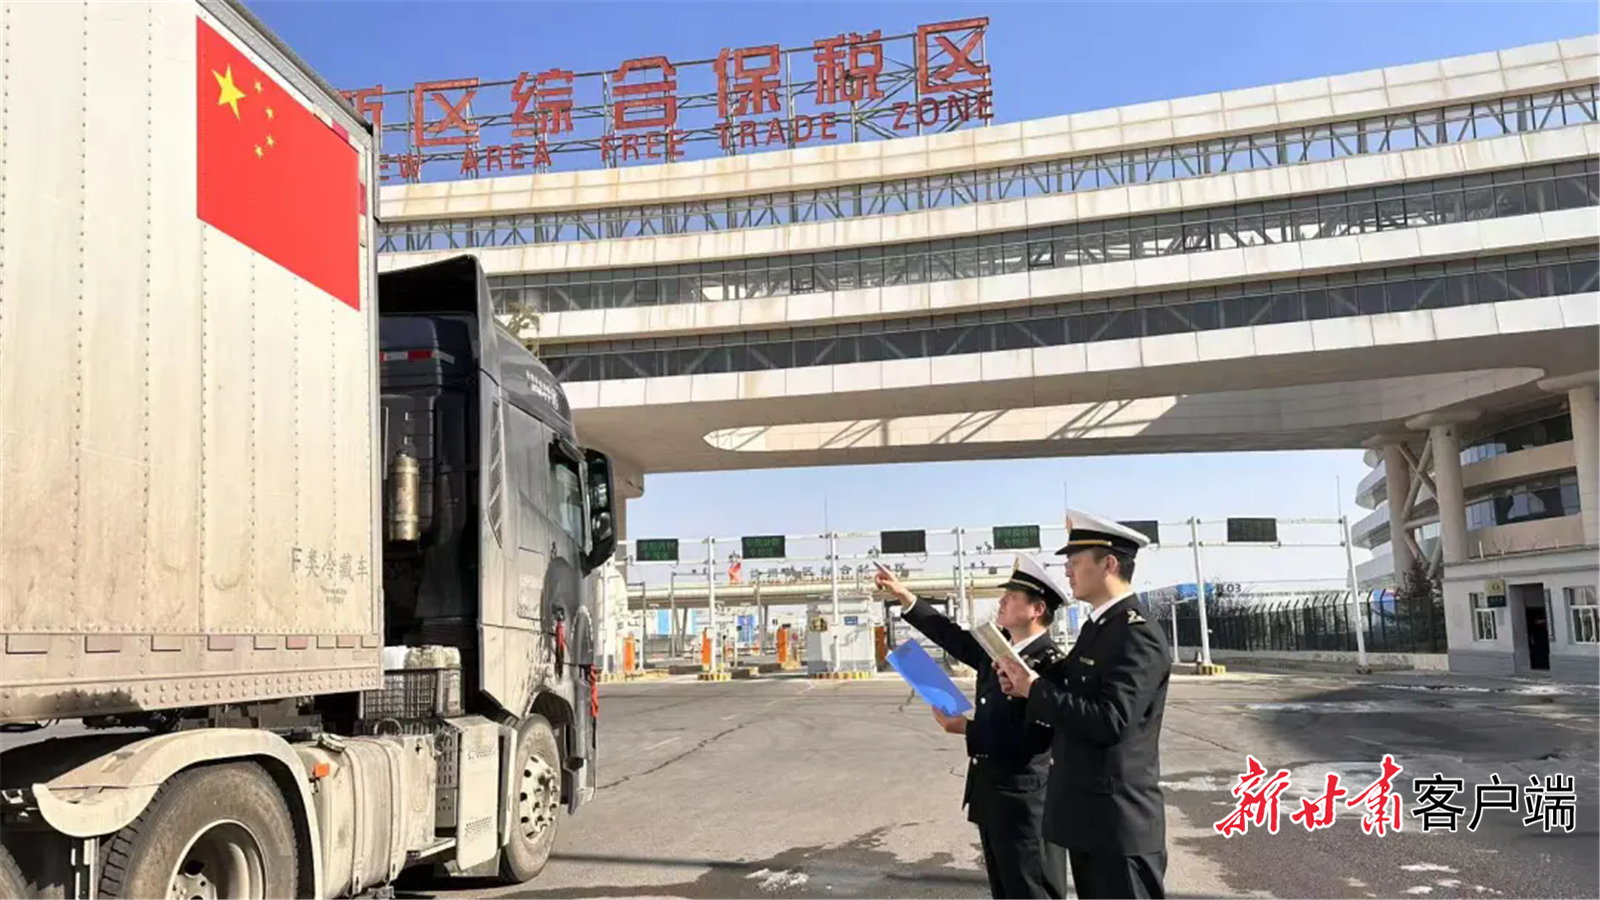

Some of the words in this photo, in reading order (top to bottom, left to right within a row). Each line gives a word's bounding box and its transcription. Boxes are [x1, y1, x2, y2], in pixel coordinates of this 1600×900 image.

[461, 141, 552, 174] AREA
[601, 129, 686, 162] FREE
[715, 112, 837, 149] TRADE
[892, 91, 994, 130] ZONE
[291, 547, 368, 583] F类冷藏车
